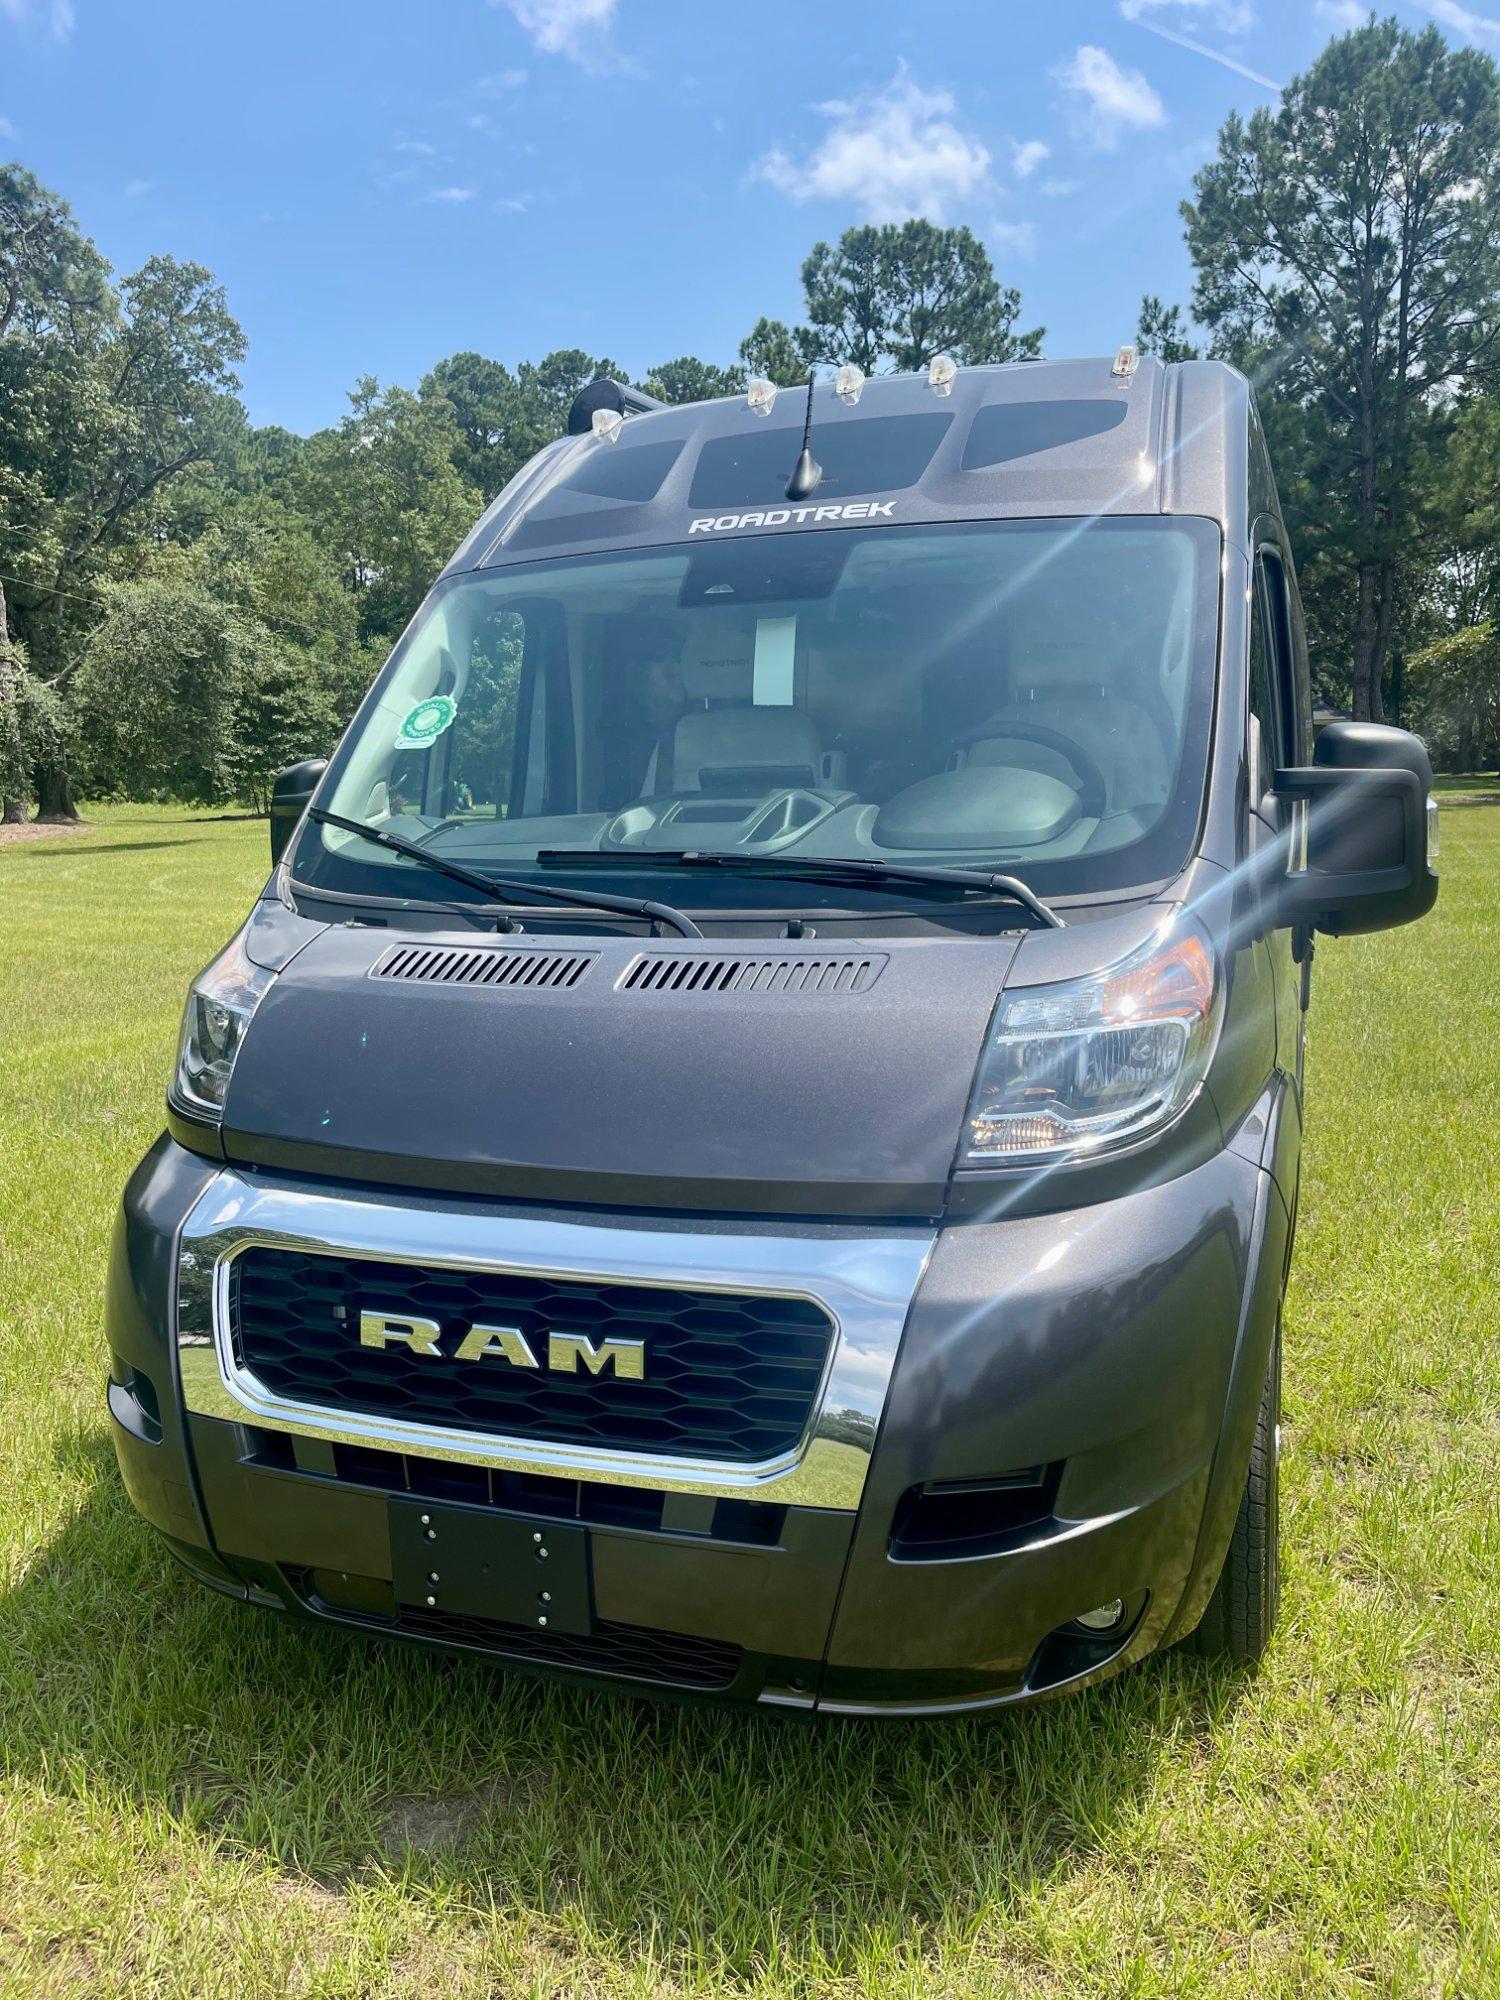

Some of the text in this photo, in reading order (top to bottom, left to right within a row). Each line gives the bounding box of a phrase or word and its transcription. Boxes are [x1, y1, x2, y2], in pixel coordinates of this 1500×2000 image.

[688, 501, 898, 534] ROADTREK
[417, 702, 448, 713] QUALITY
[406, 722, 441, 737] APPROVED
[359, 1309, 646, 1381] RAM
